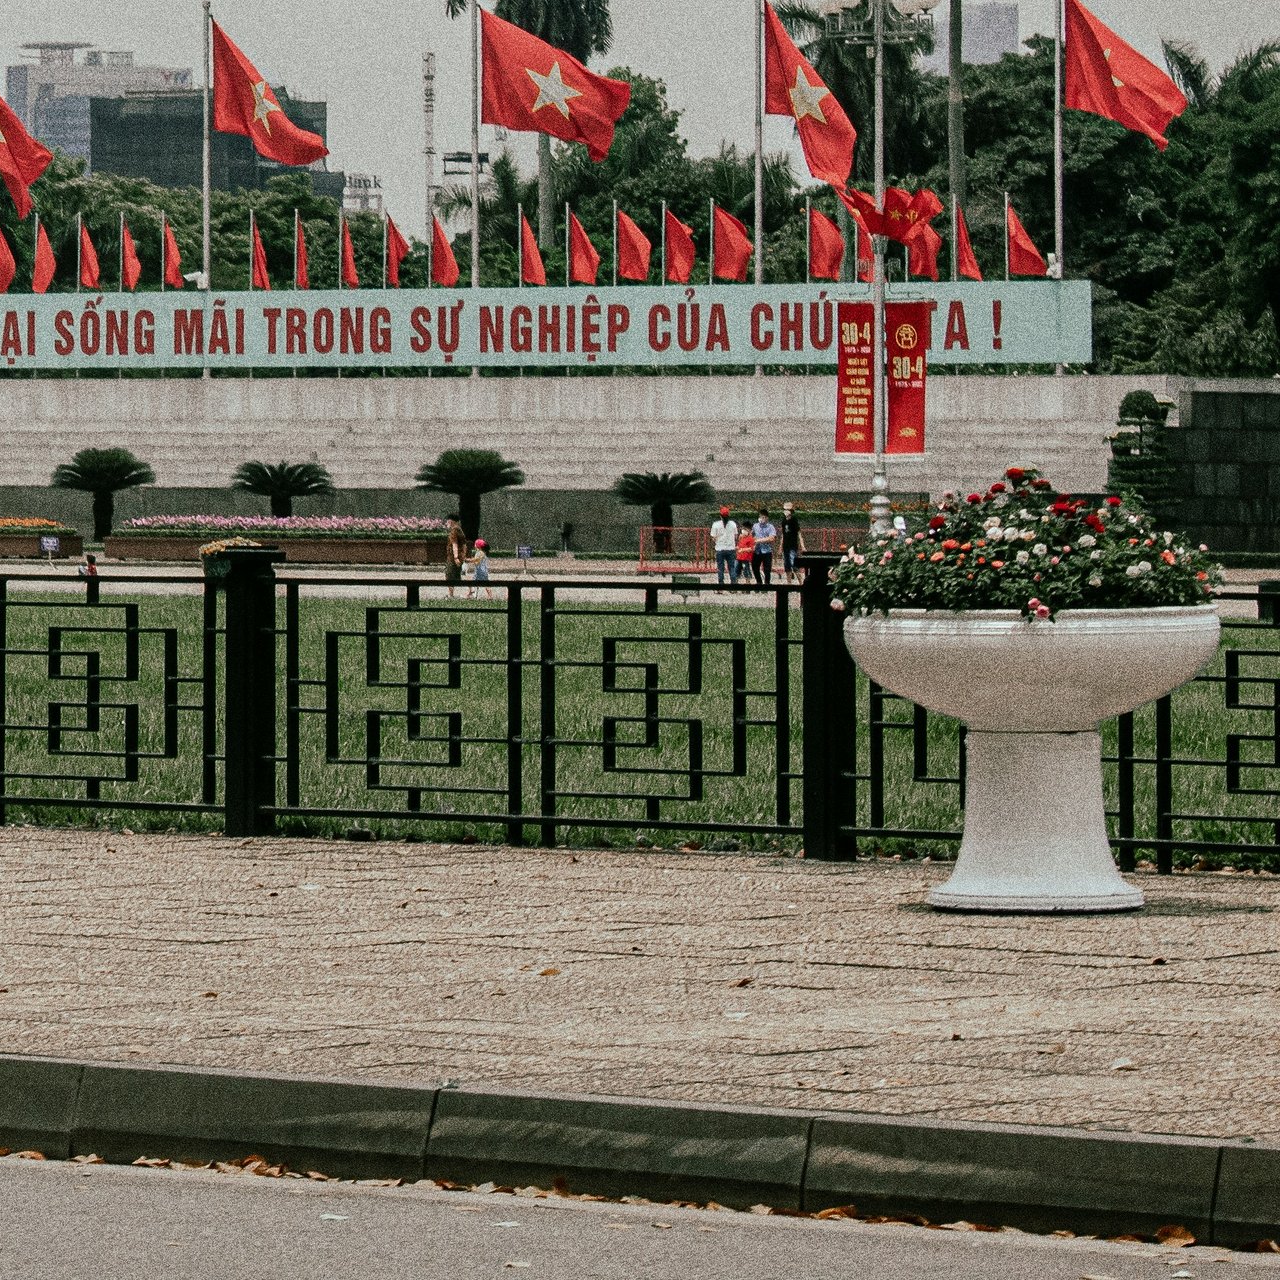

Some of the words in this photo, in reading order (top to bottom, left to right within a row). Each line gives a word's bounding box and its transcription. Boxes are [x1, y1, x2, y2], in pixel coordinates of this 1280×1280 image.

[55, 296, 155, 356] SỐNG
[174, 299, 245, 355] MÃI
[263, 307, 392, 354] TRONG
[410, 300, 464, 361] SỰ
[480, 295, 630, 361] NGHIỆP
[648, 288, 730, 352] CỦA
